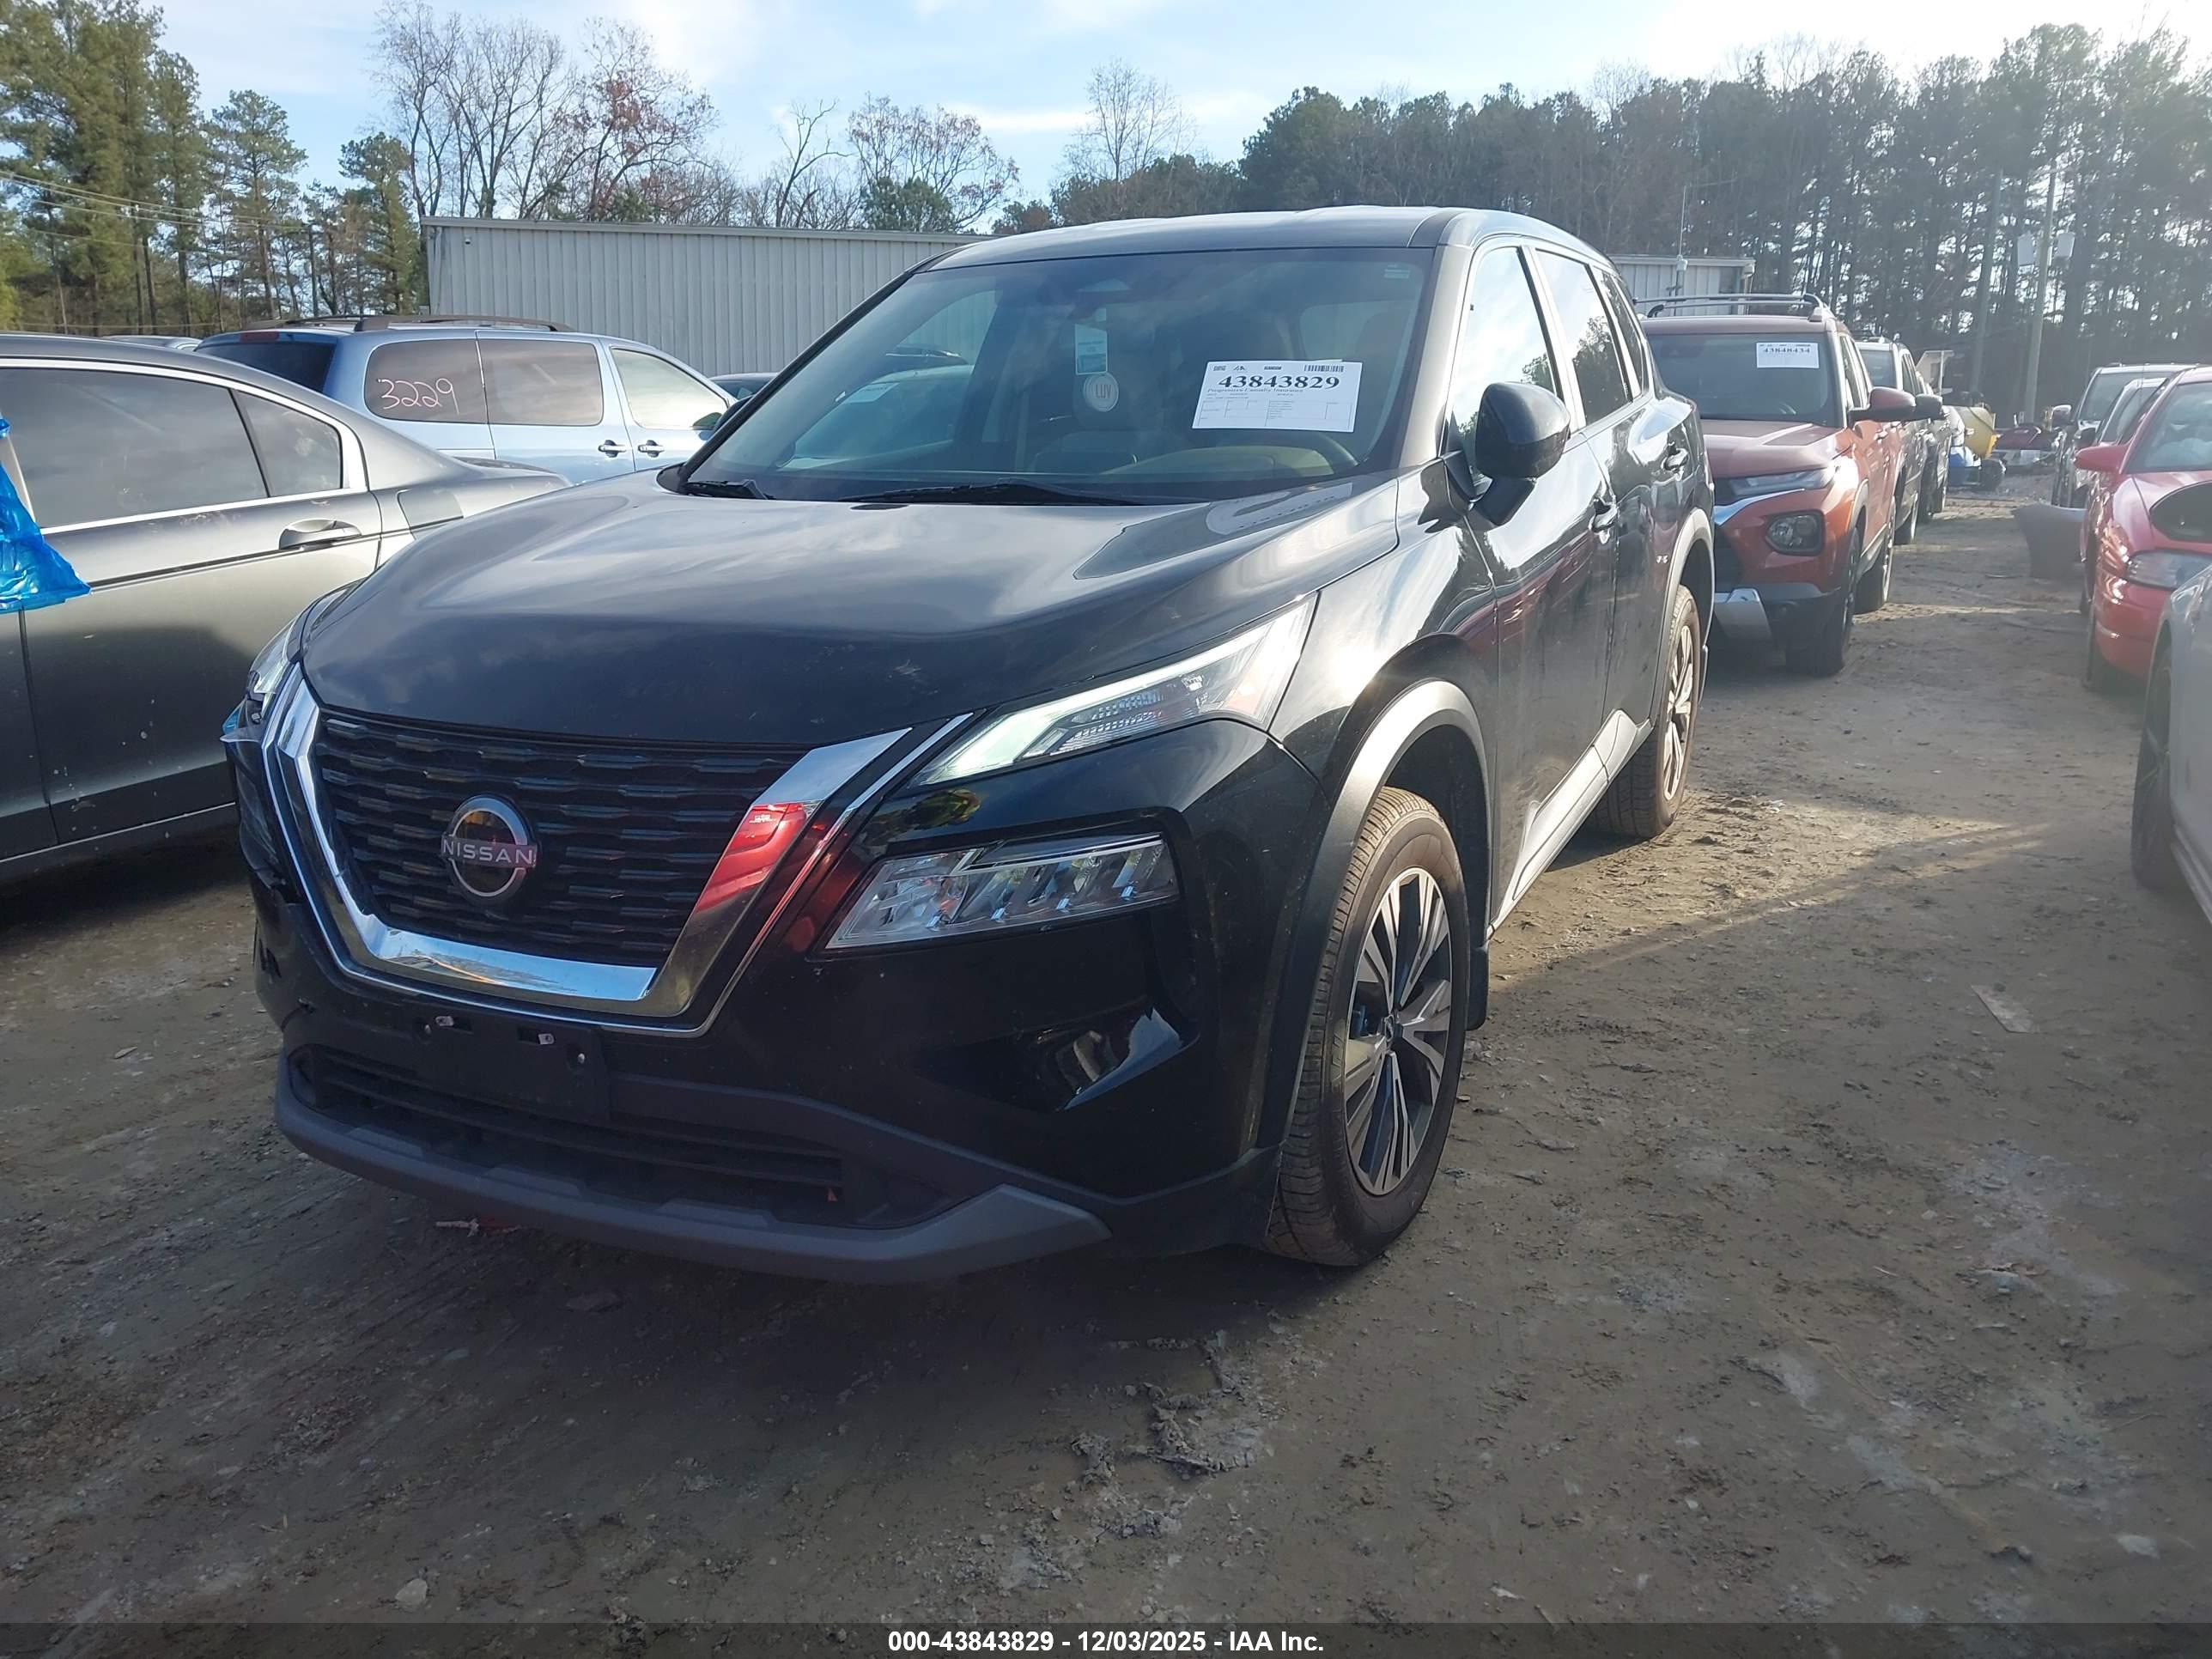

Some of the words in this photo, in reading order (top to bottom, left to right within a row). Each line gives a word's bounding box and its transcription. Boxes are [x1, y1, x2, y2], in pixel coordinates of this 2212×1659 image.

[1218, 375, 1340, 389] 43843829
[377, 378, 459, 415] 3229
[442, 839, 532, 865] NISSAN
